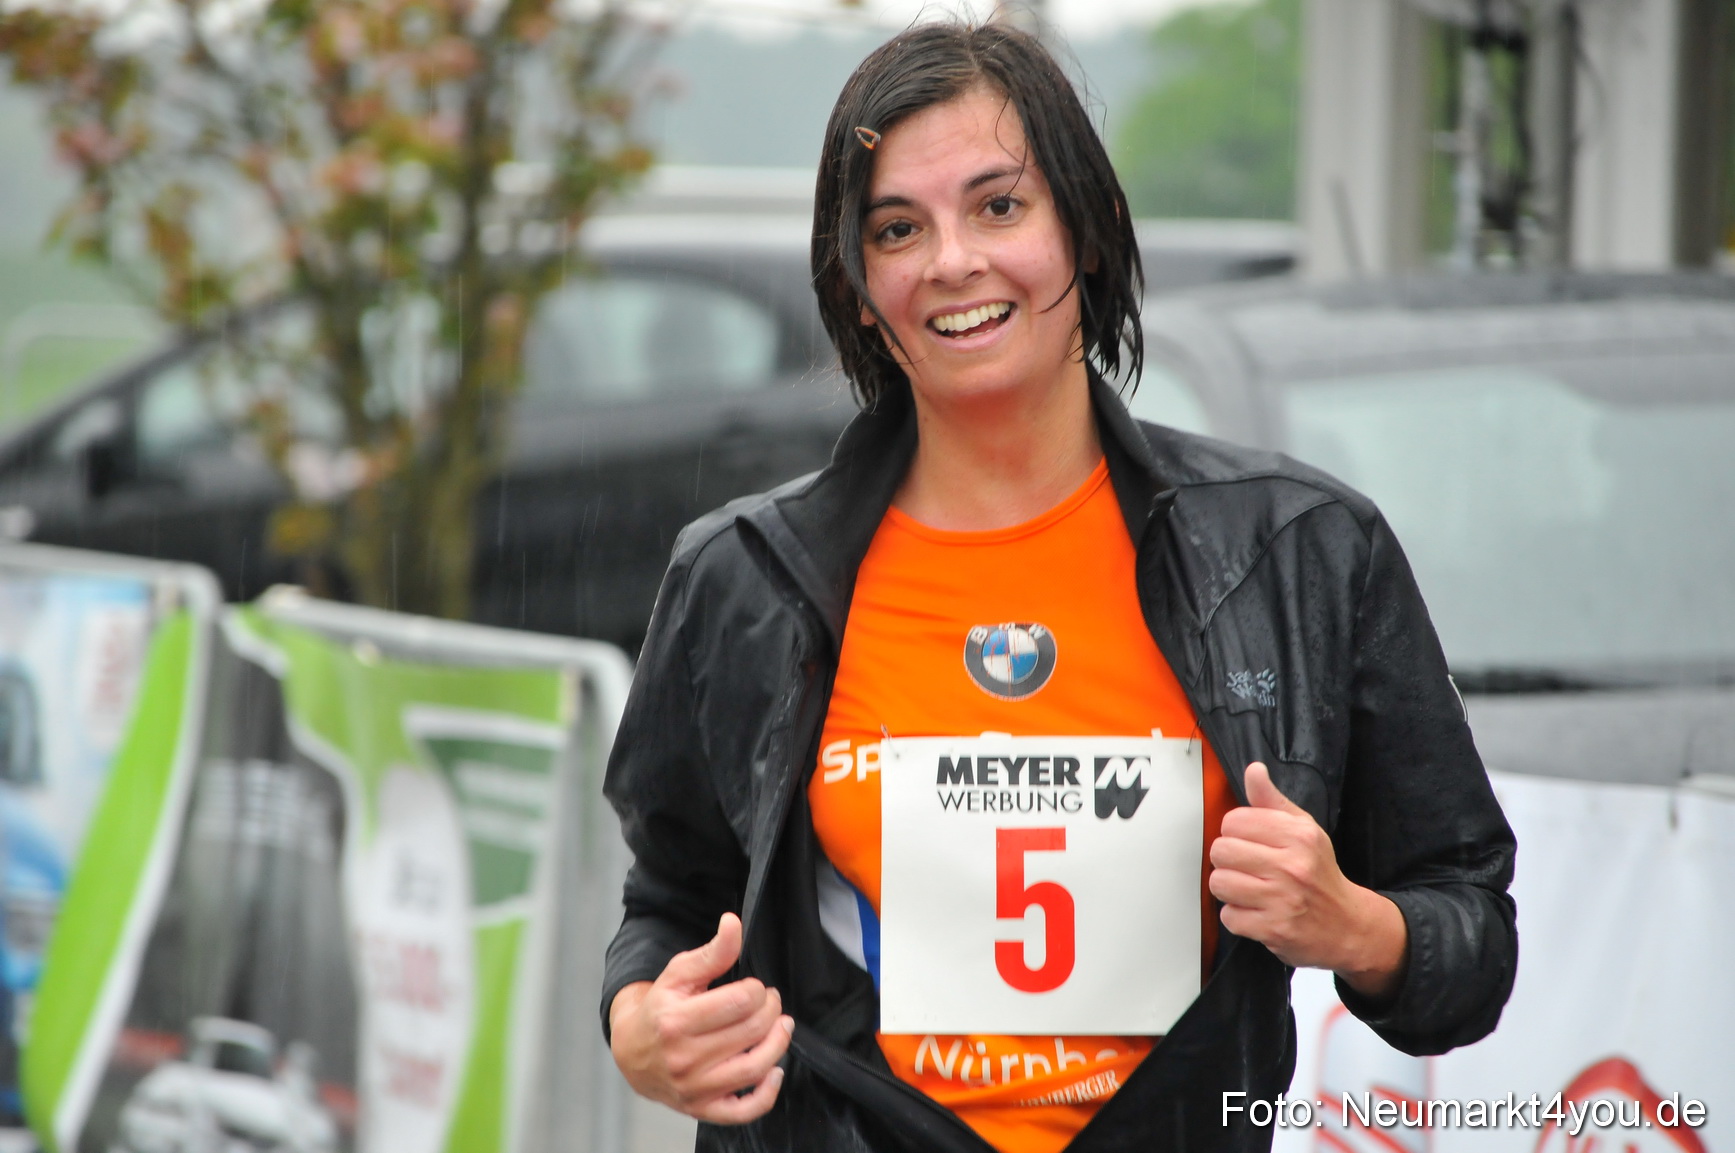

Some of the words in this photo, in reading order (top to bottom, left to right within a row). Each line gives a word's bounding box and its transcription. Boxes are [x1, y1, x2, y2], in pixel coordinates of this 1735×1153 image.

[936, 756, 1081, 786] MEYER
[936, 790, 1084, 814] WERBUNG
[994, 826, 1076, 994] 5
